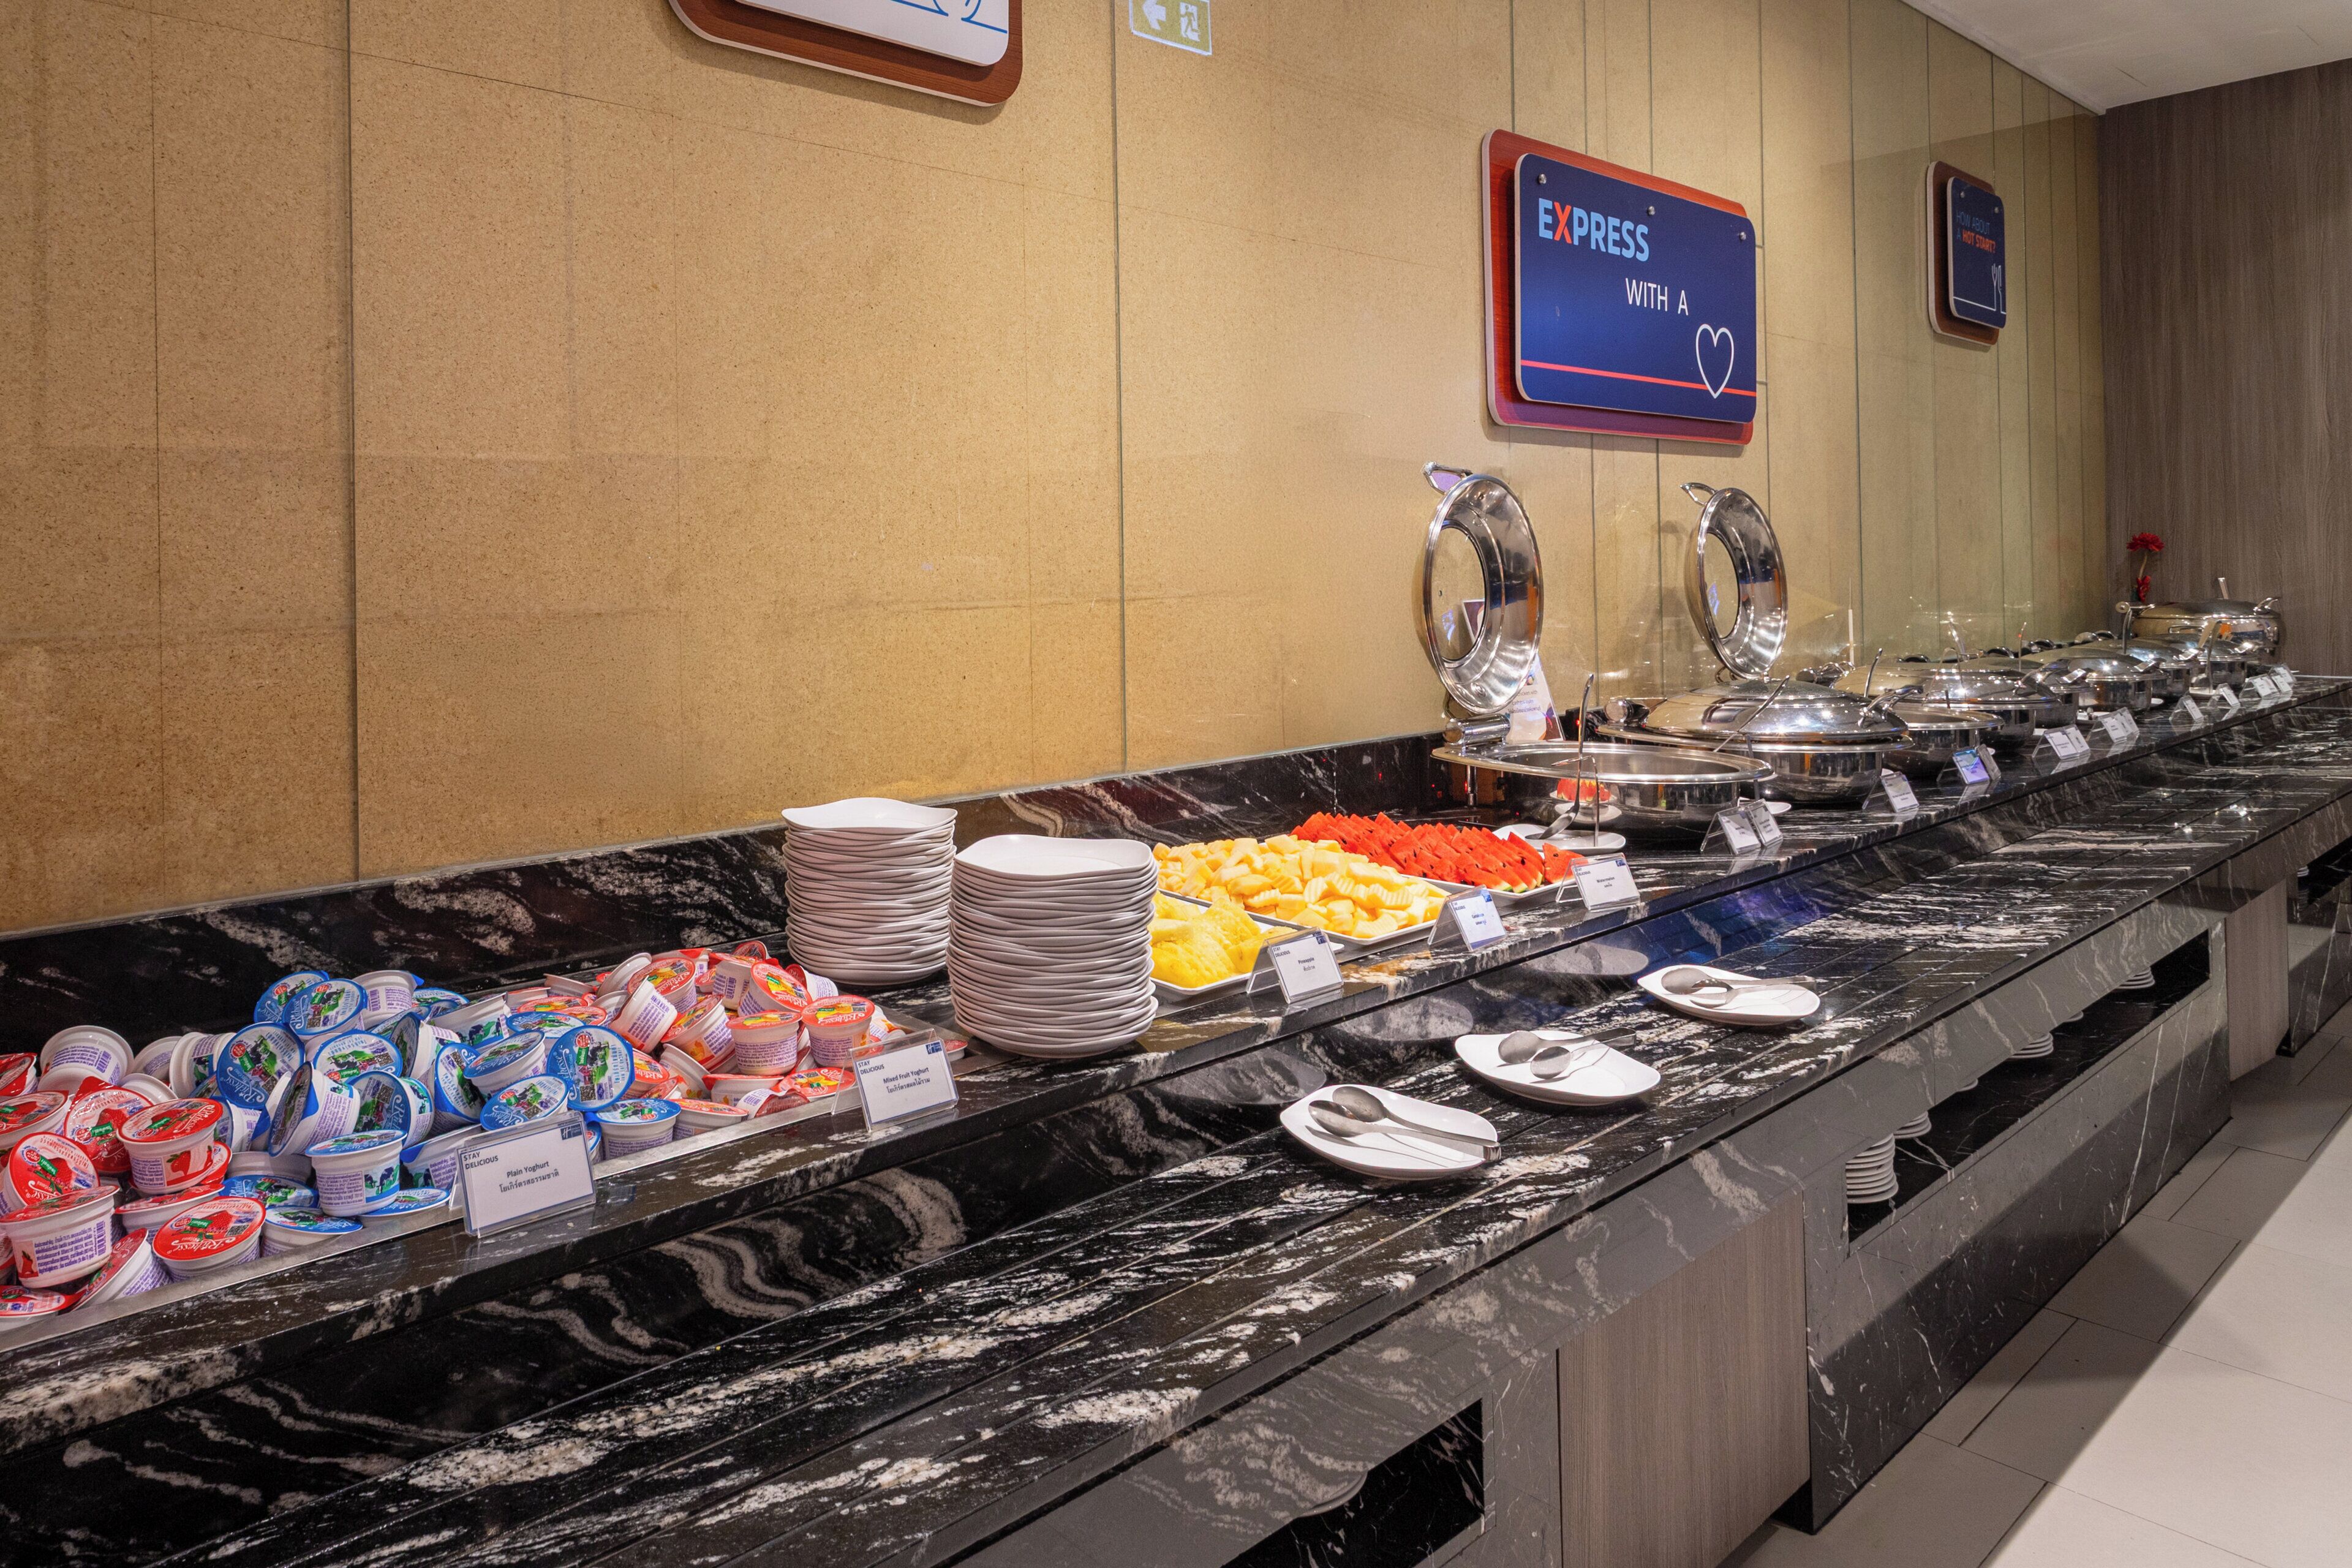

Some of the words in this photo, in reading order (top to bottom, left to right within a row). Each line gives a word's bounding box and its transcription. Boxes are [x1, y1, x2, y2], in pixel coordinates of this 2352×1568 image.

[1539, 197, 1649, 262] EXPRESS
[1956, 210, 1970, 227] HOW
[1972, 216, 1990, 235] ABOUT
[1956, 227, 1961, 239] A
[1962, 228, 1975, 246] HOT
[1975, 233, 1996, 254] START?
[1625, 277, 1668, 312] WITH
[1678, 290, 1689, 316] A
[858, 1060, 870, 1068] STAY
[860, 1064, 885, 1075] DELICIOUS
[883, 1075, 899, 1084] Mixed
[910, 1067, 930, 1077] Yoghurt
[464, 1152, 481, 1161] STAY
[465, 1155, 499, 1170] DELICIOUS
[507, 1166, 523, 1178] Plain
[524, 1161, 549, 1174] Yoghurt
